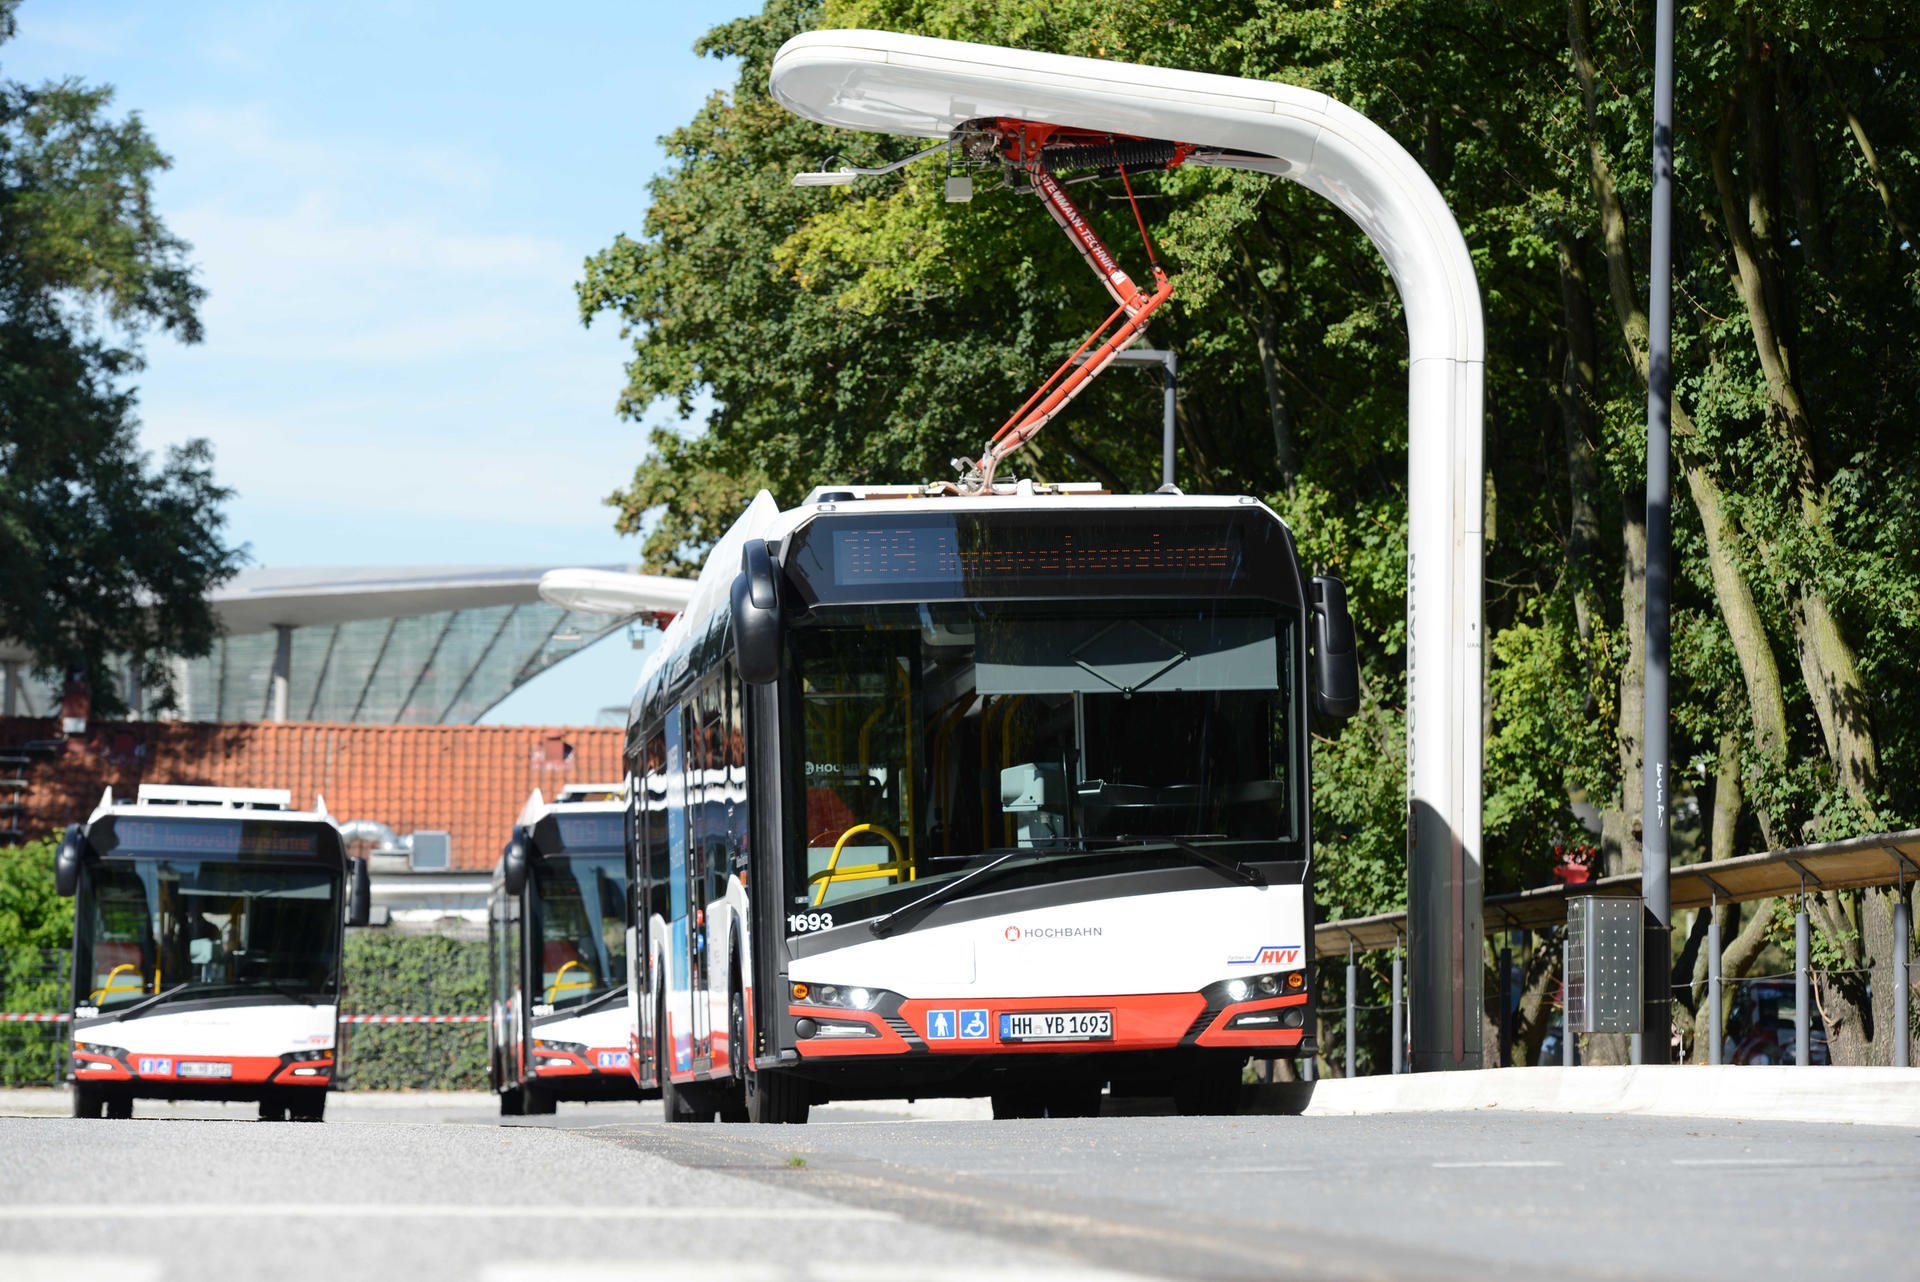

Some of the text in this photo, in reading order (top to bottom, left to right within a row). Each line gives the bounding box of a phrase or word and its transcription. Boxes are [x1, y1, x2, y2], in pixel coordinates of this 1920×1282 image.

[1041, 173, 1117, 272] STEMMANN-TECHNIK
[787, 913, 833, 932] 1693
[1024, 927, 1102, 938] HOCHBAHN
[1262, 950, 1299, 963] HVV
[1012, 1015, 1109, 1034] HH YB 1693
